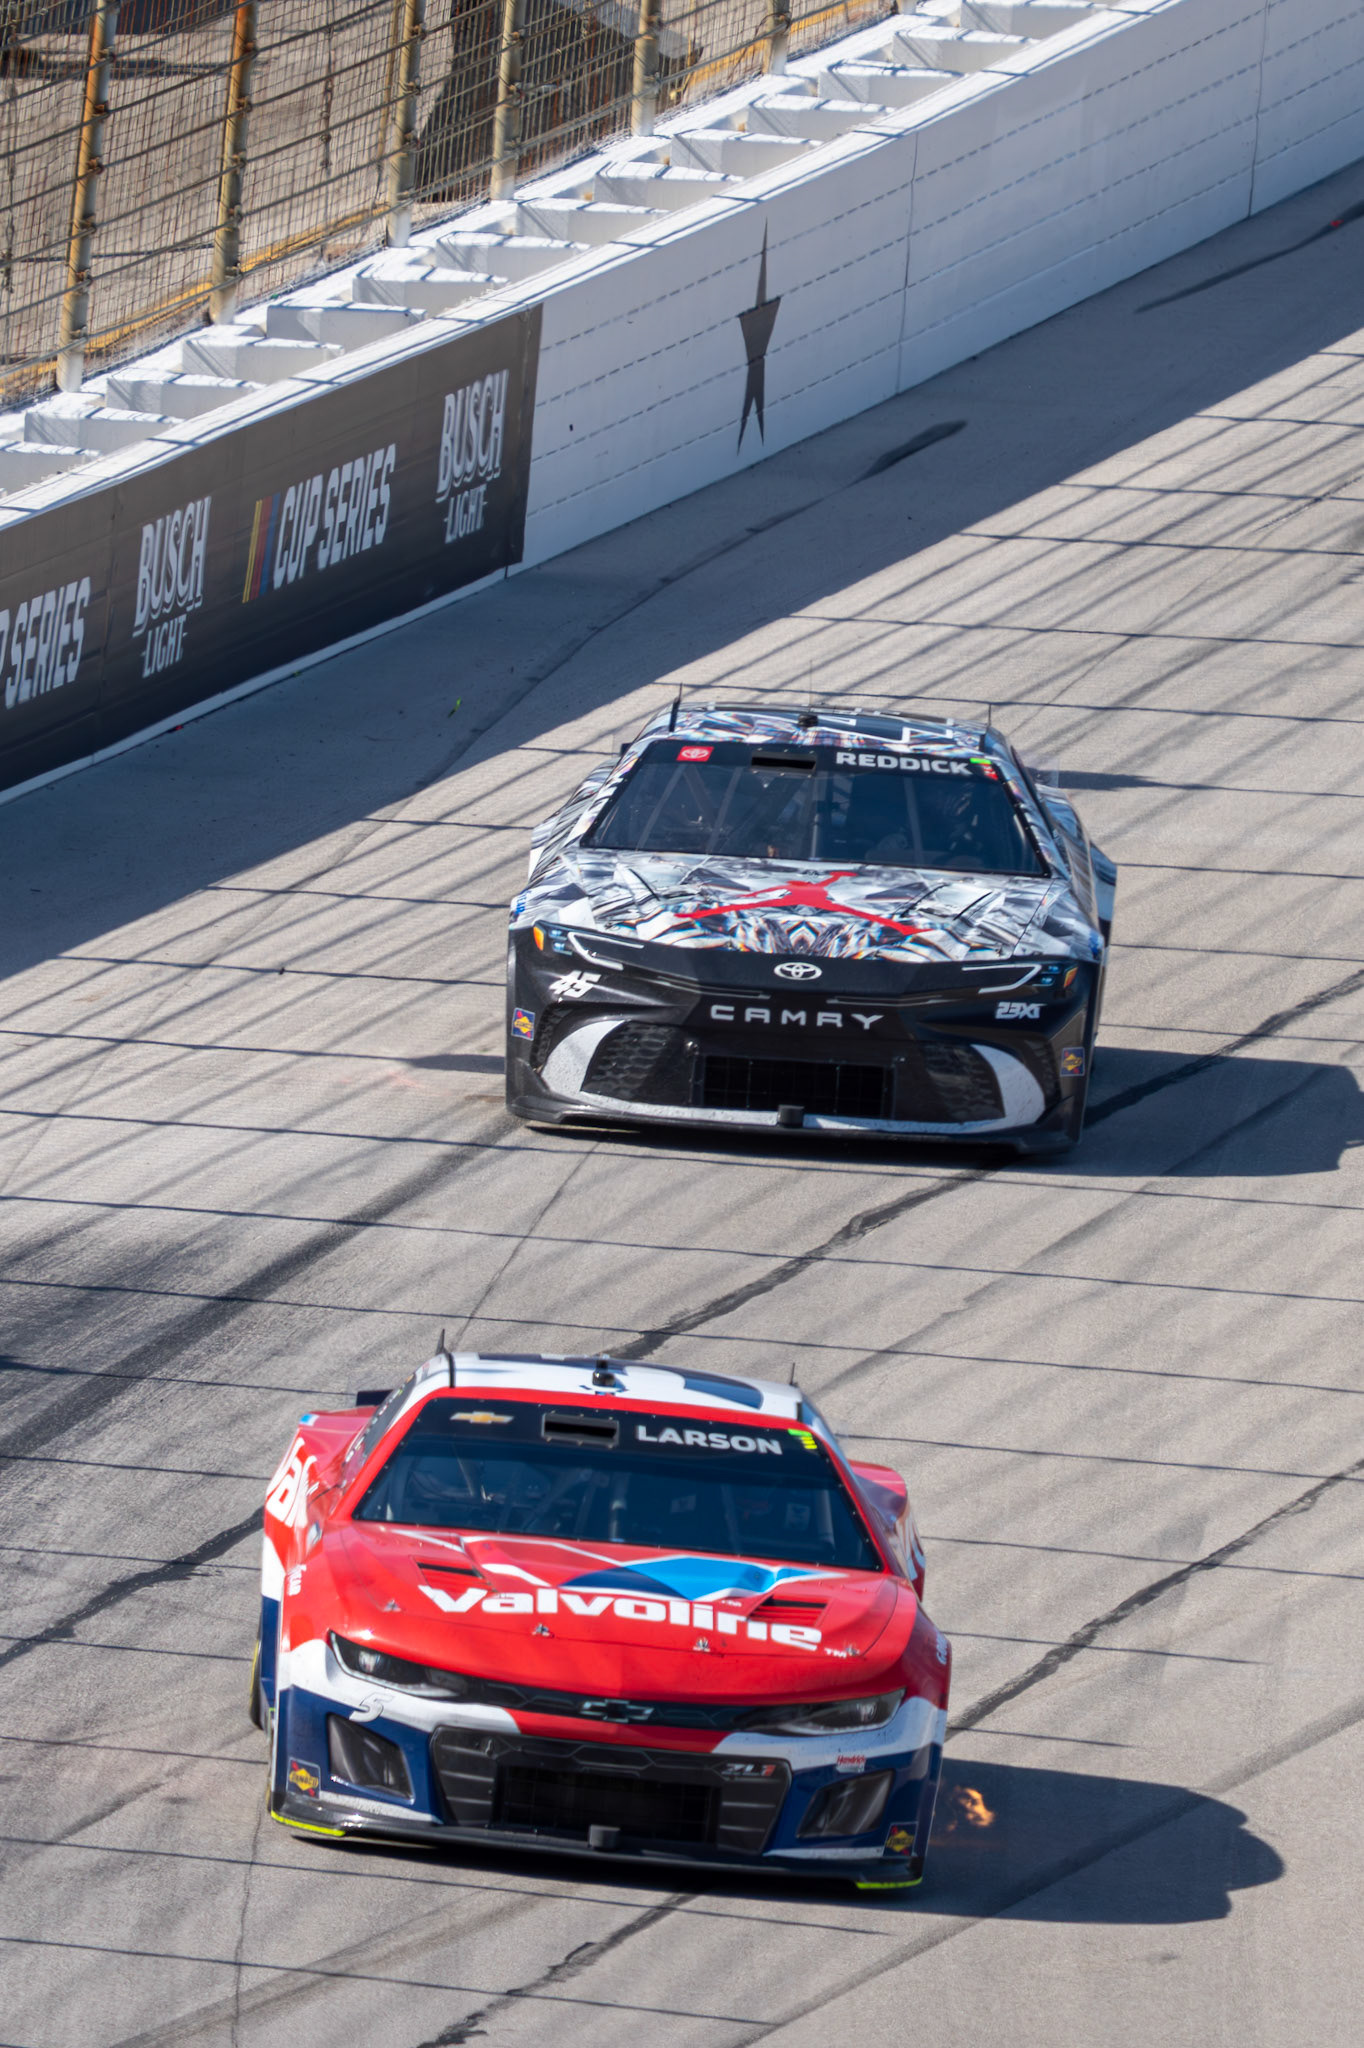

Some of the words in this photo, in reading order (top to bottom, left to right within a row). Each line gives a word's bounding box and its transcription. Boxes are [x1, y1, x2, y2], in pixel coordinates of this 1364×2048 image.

[435, 369, 509, 503] BUSCH
[273, 474, 323, 590] CUP
[317, 443, 396, 571] SERIES
[444, 483, 487, 544] LIGHT
[132, 496, 212, 637] BUSCH
[5, 576, 91, 709] SERIES
[141, 614, 188, 678] LIGHT
[835, 751, 973, 775] REDDICK
[549, 970, 602, 1003] 45
[710, 1004, 884, 1030] CAMRY
[636, 1425, 783, 1455] LARSON
[418, 1585, 822, 1651] Valvoline
[349, 1692, 396, 1722] 5
[721, 1763, 777, 1777] ZL1
